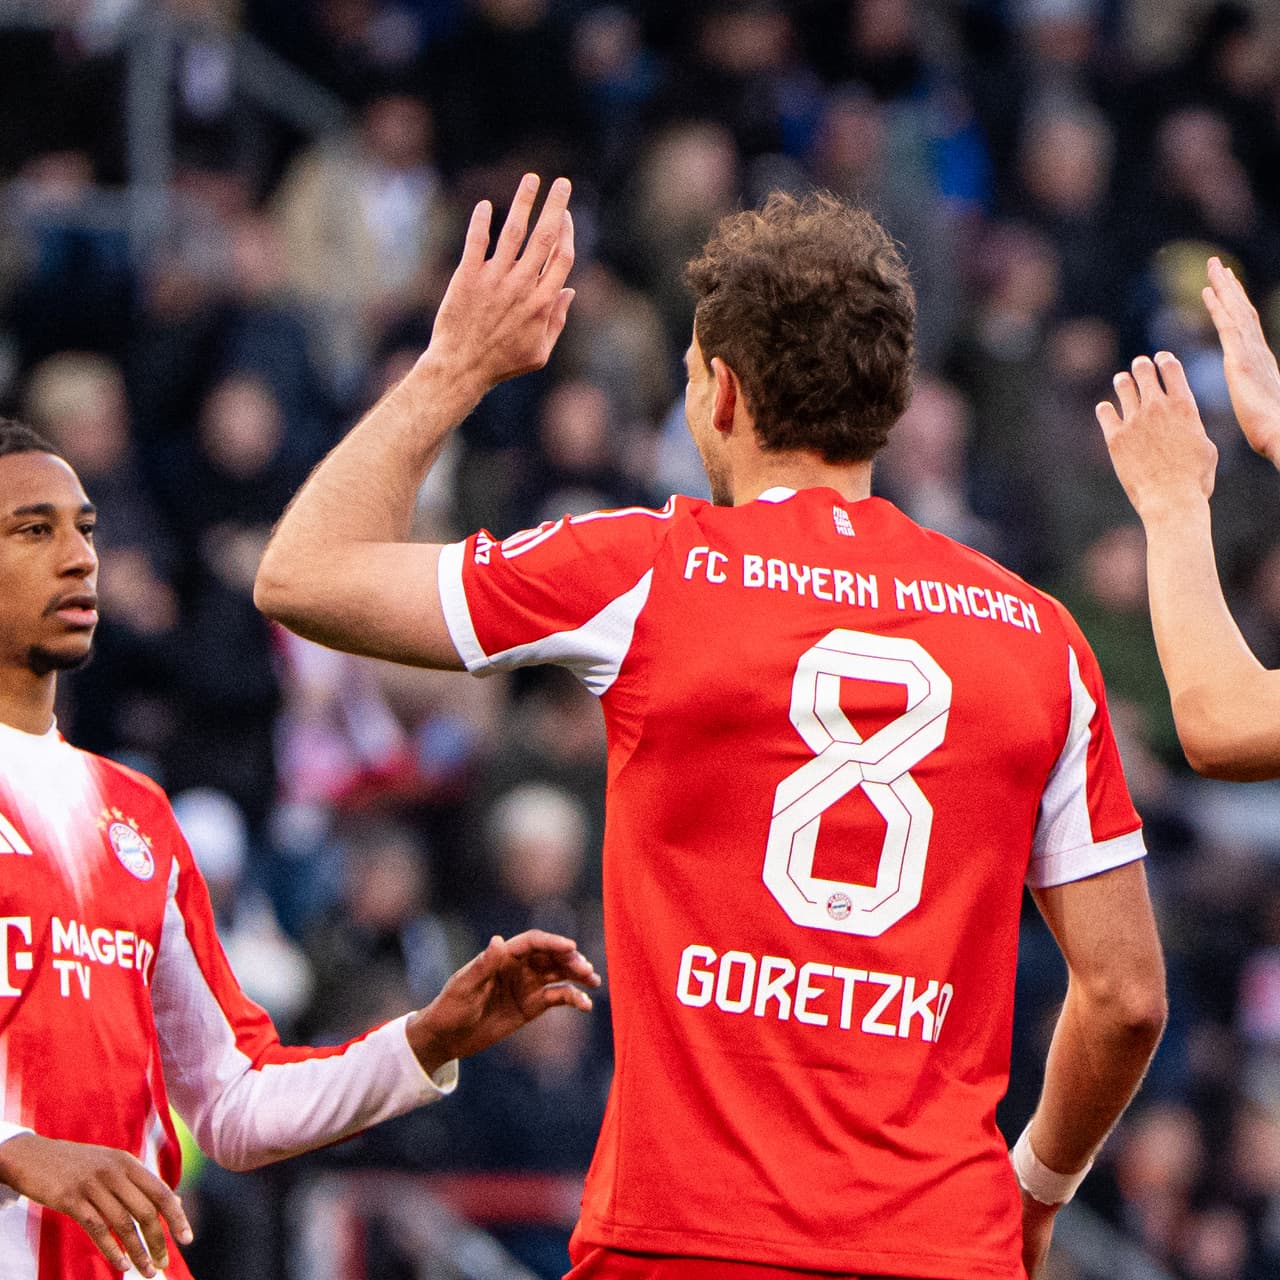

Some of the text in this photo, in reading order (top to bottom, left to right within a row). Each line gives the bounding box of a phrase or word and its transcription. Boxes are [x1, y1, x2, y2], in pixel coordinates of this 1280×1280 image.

[683, 546, 1042, 634] FC BAYERN MÜNCHEN
[761, 627, 953, 937] 8
[51, 959, 92, 1000] TV
